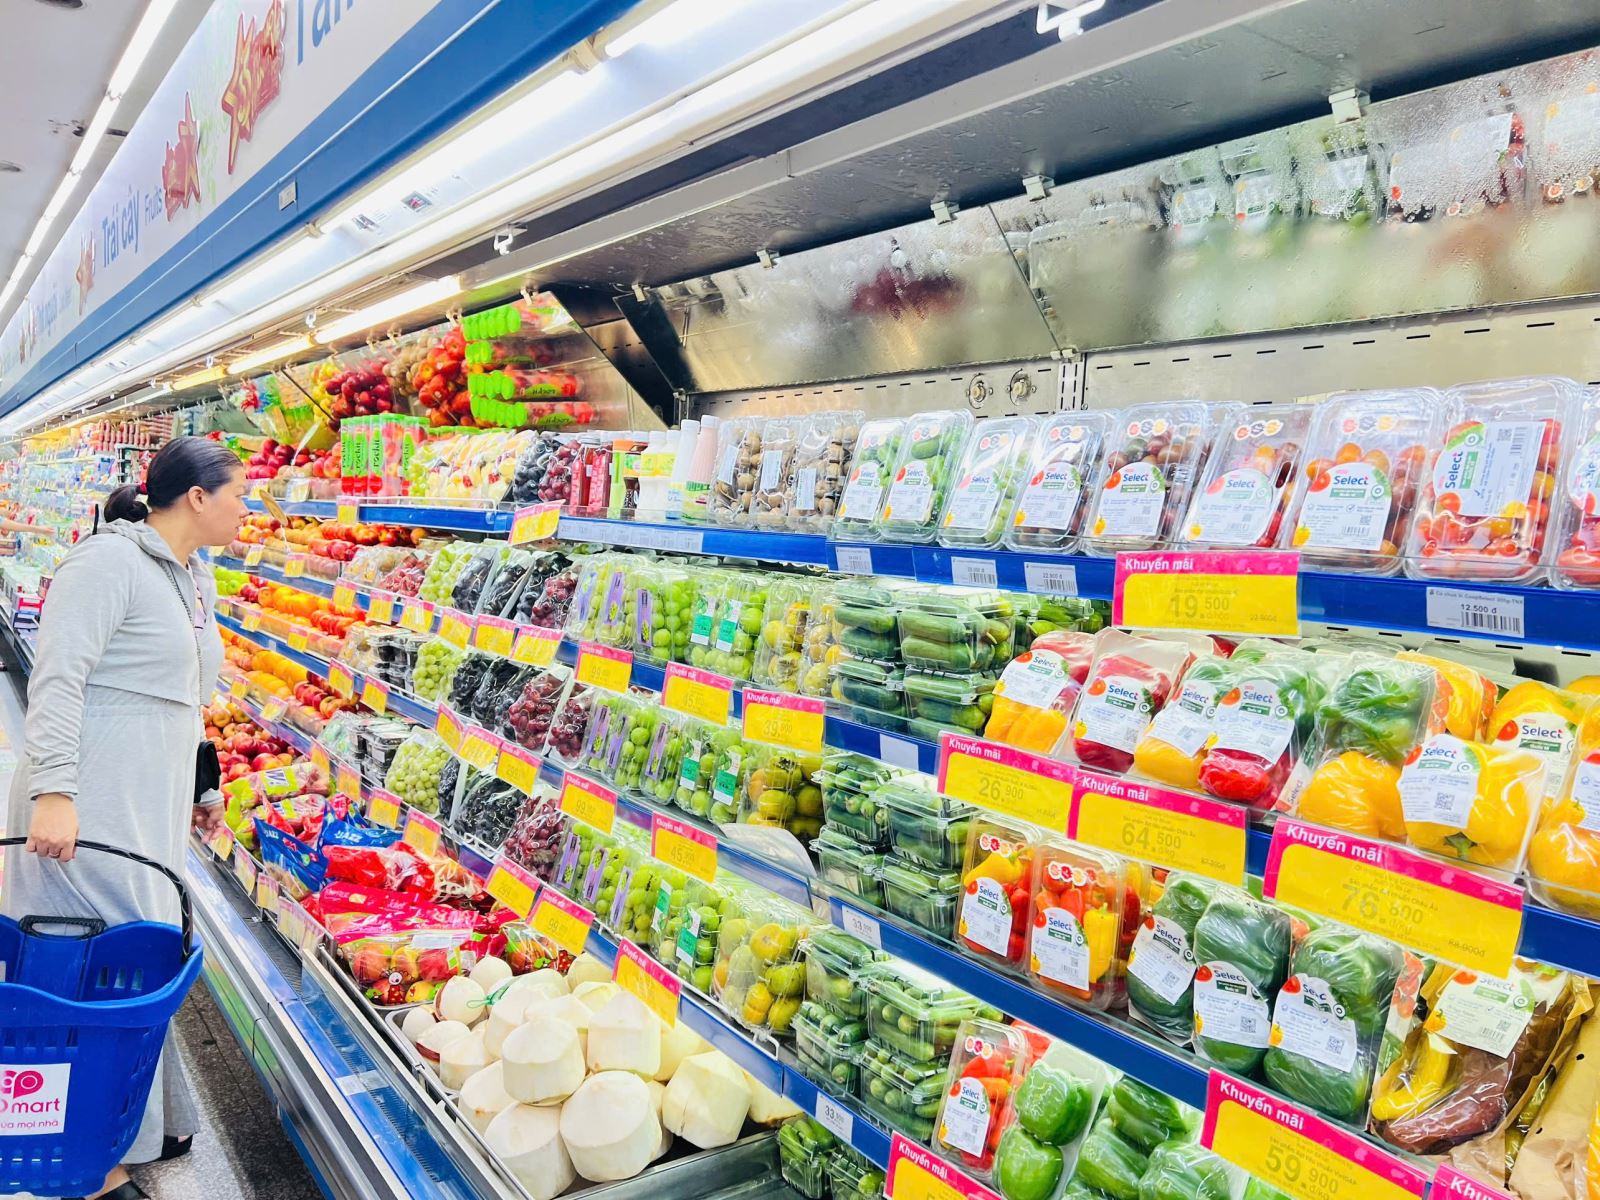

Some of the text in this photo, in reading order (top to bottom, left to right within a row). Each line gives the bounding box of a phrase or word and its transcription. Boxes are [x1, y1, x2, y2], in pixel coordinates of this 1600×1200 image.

[102, 203, 118, 268] Trái
[121, 184, 140, 254] cây
[1045, 472, 1068, 480] Select
[1445, 451, 1463, 489] Select
[1226, 479, 1256, 488] Select
[1333, 475, 1369, 485] Select
[1125, 556, 1194, 573] Khuyến mãi
[1033, 656, 1057, 668] Select
[1108, 684, 1139, 700] Select
[1183, 688, 1209, 703] Select
[1243, 691, 1273, 704] Select
[1522, 725, 1563, 739] Select
[949, 737, 1001, 761] Khuyến mãi
[1423, 747, 1457, 760] Select
[1081, 776, 1149, 801] Khuyến mãi
[1286, 824, 1383, 863] Khuyến mãi
[979, 886, 999, 900] Select
[1048, 917, 1072, 931] Select
[1156, 924, 1182, 946] Select
[1214, 970, 1247, 982] Select
[962, 1086, 980, 1100] Select
[1220, 1079, 1304, 1130] Khuyến mãi
[898, 1140, 948, 1180] Khuyến mãi
